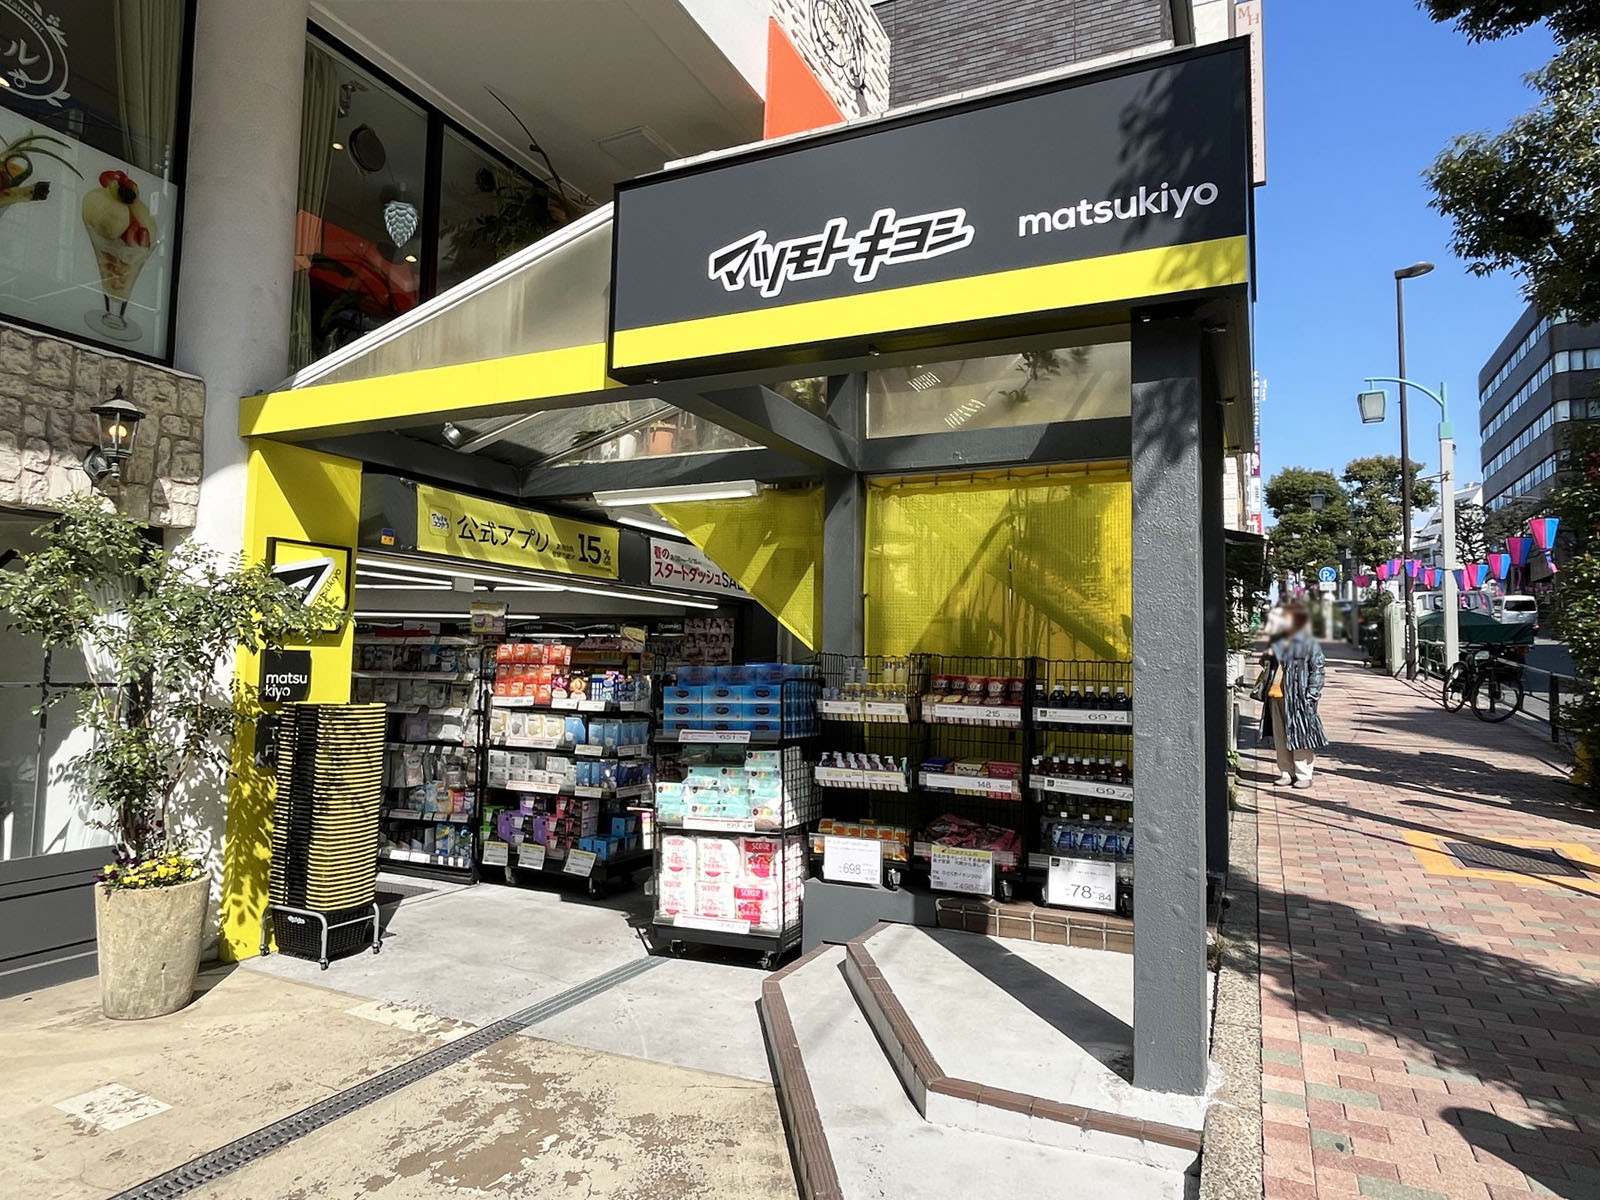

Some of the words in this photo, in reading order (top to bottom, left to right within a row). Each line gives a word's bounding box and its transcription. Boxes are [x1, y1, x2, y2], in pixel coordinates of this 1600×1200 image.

[1018, 182, 1218, 237] matsukiyo
[708, 207, 975, 298] マツモトキヨシ
[457, 514, 549, 552] 公式アプリ
[265, 672, 308, 685] matsu
[265, 684, 292, 702] kiyo
[985, 709, 1001, 718] 215
[842, 862, 862, 875] 698
[1070, 884, 1092, 899] 78
[1098, 892, 1112, 902] 84
